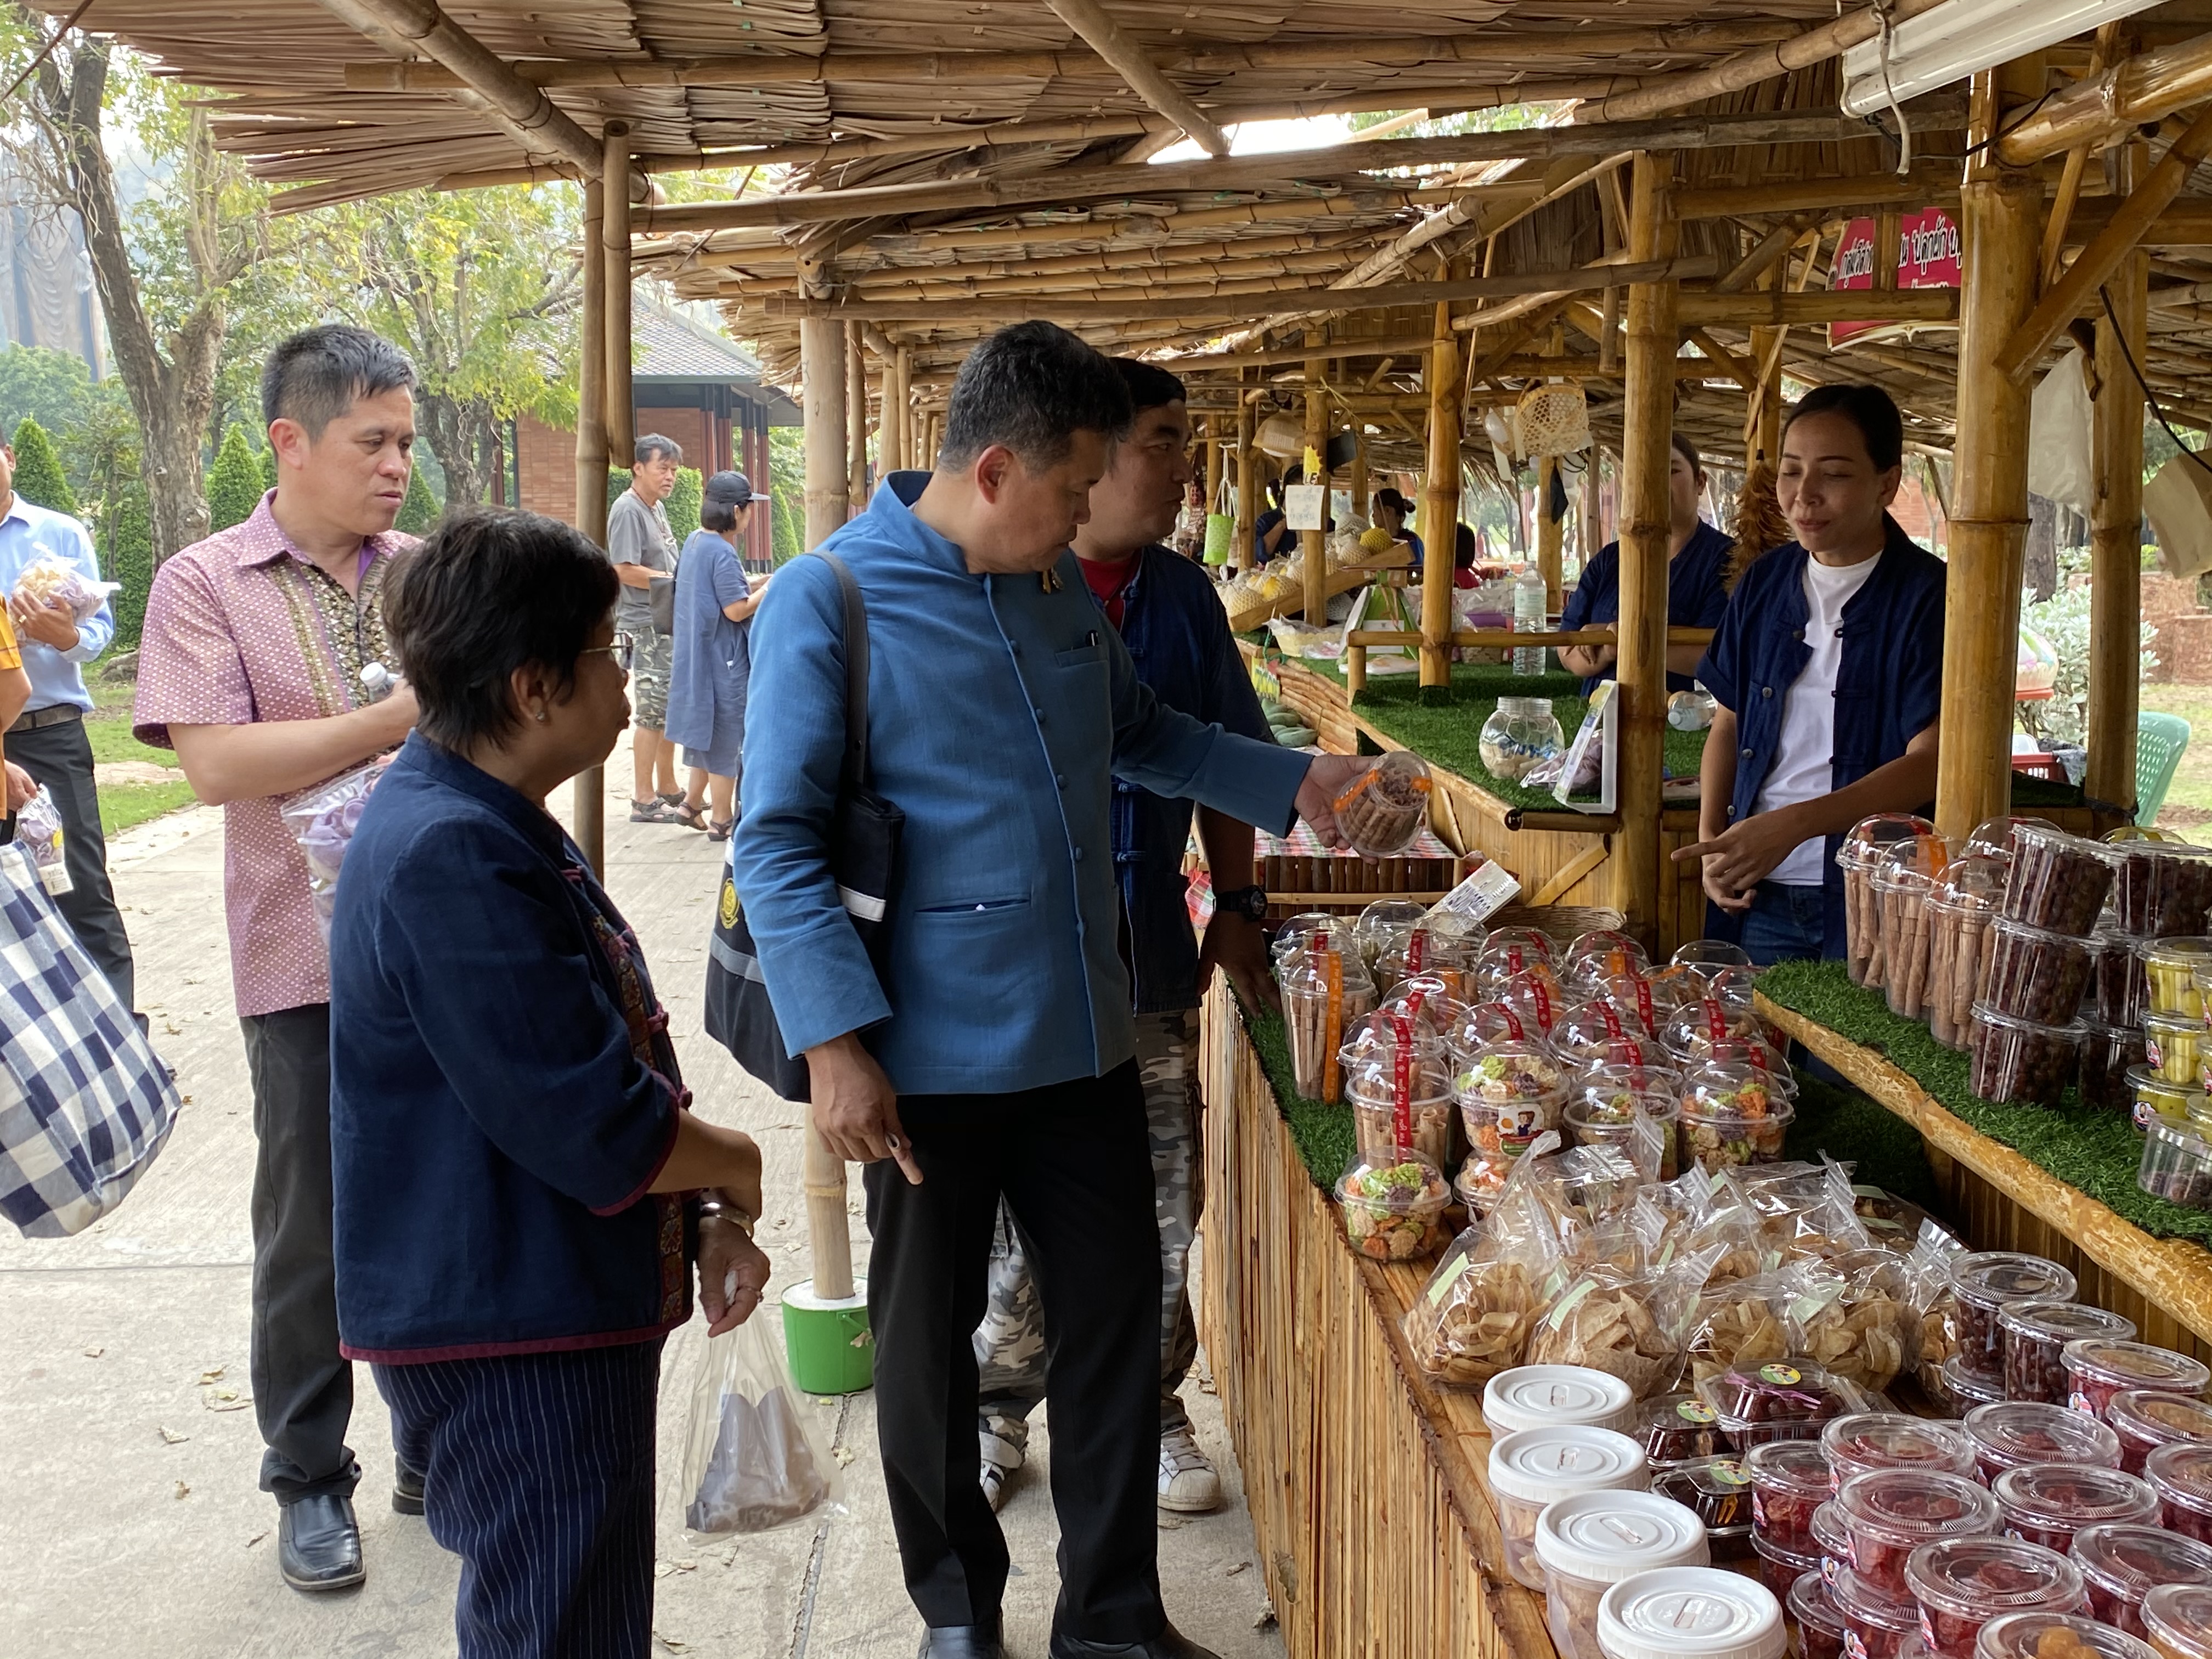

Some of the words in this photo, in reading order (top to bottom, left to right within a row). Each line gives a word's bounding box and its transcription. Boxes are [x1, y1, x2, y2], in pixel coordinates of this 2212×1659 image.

[1911, 215, 1948, 275] ปลูกผัก
[1396, 1078, 1406, 1092] you
[1399, 1119, 1408, 1131] you
